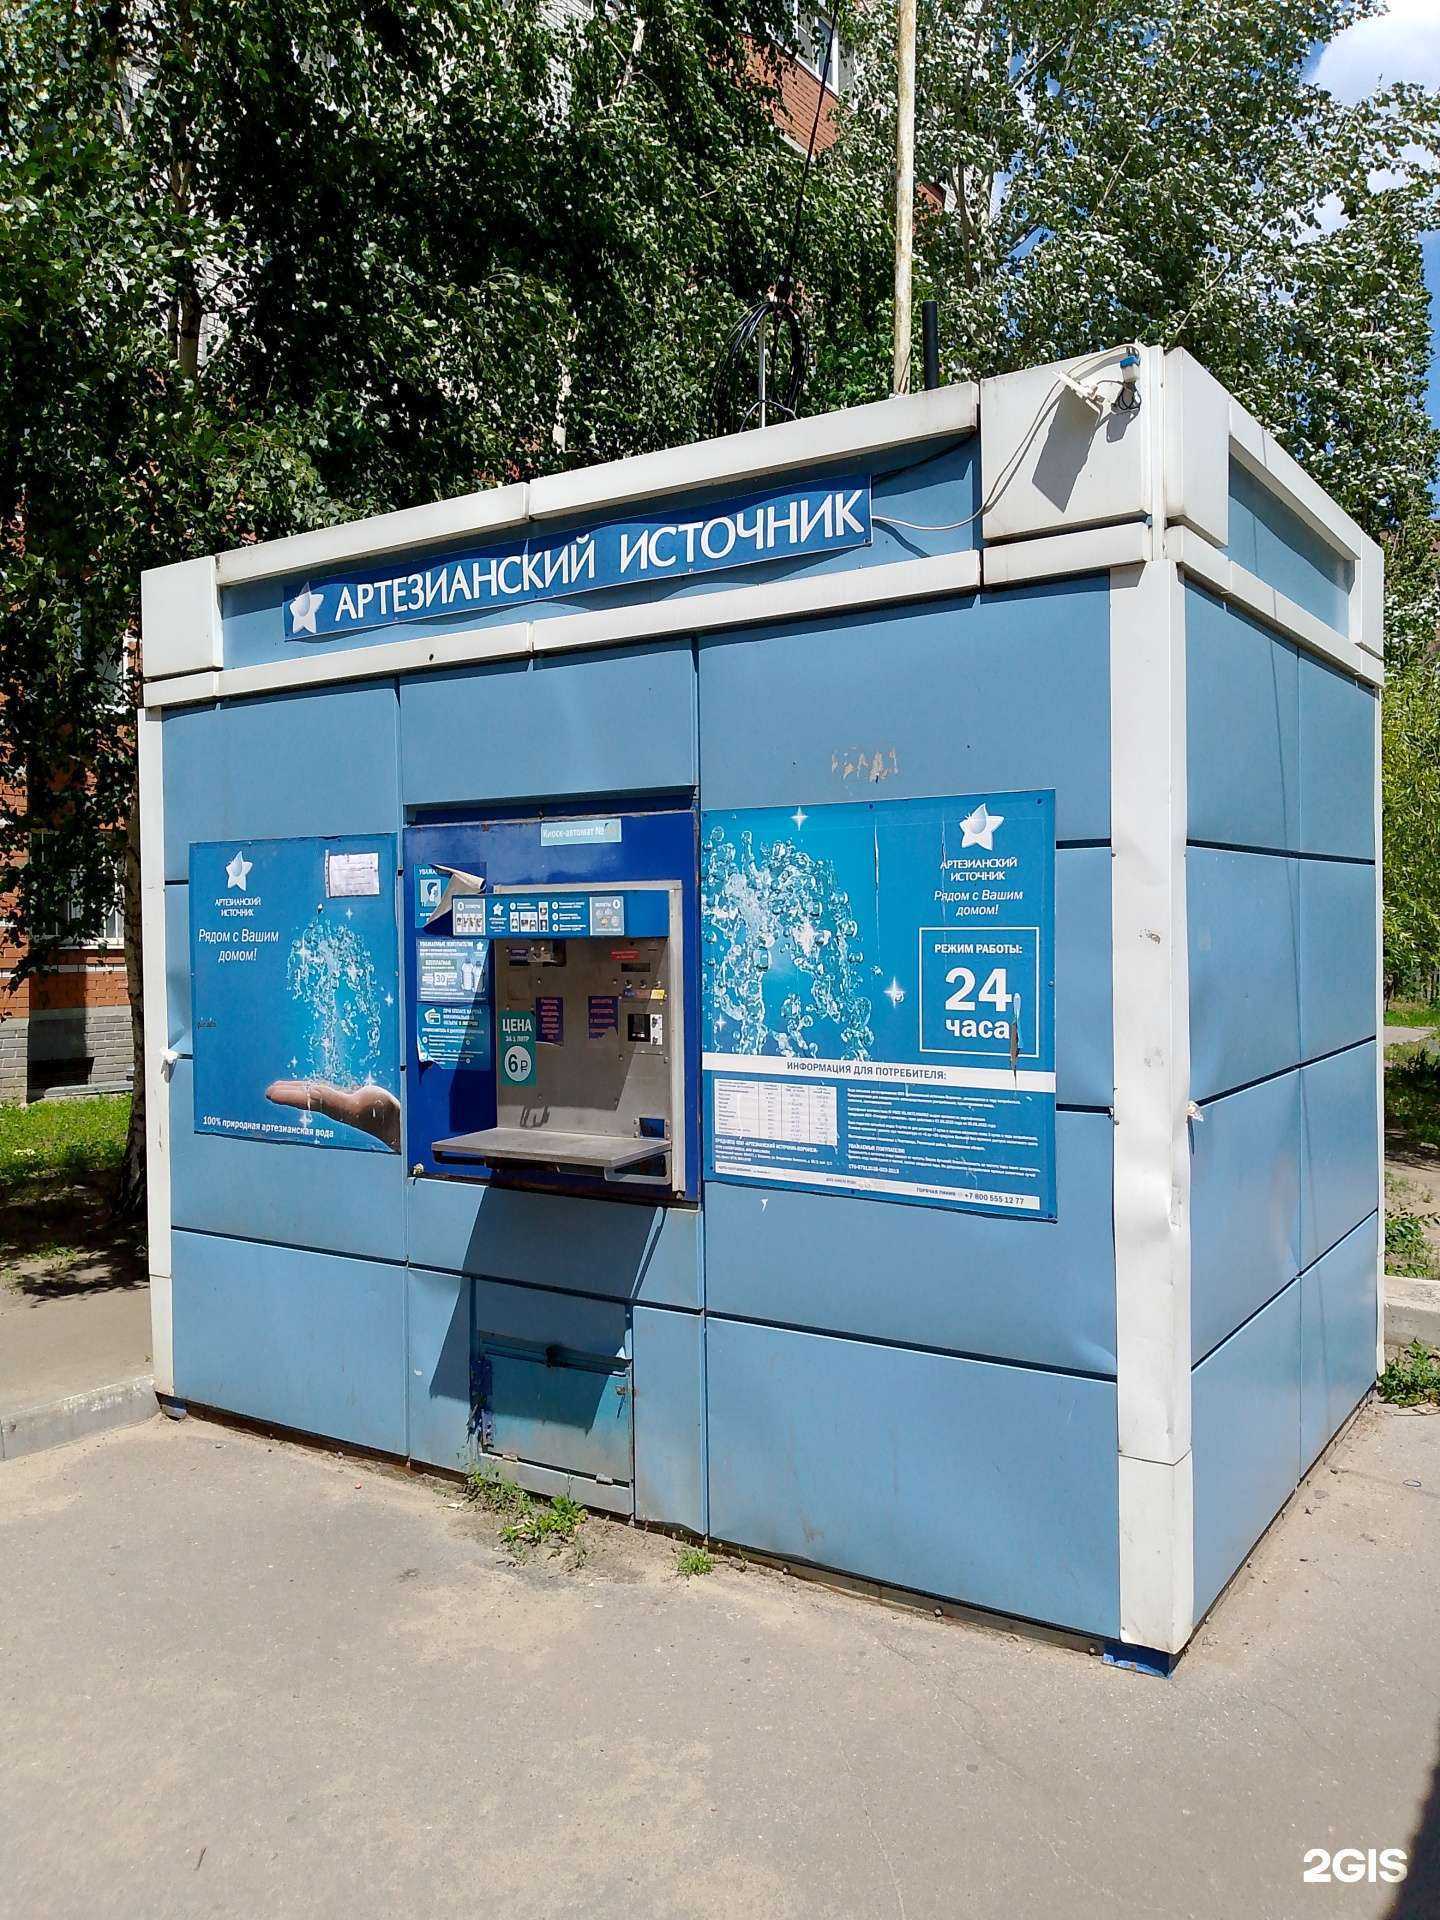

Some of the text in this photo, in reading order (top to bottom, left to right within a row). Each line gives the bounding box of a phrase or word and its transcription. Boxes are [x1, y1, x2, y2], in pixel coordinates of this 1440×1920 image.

[335, 490, 865, 622] АРТЕЗИАНСКИЙ ИСТОЧНИК
[940, 857, 1018, 869] АРТЕЗИАНСКИЙ
[950, 870, 1006, 881] ИСТОЧНИК
[215, 896, 262, 907] АРТЕЗИАНСКИЙ
[934, 889, 1024, 902] Рядом с Вашим
[220, 908, 255, 917] ИСТОЧНИК
[956, 903, 999, 917] домом!
[198, 928, 279, 944] Рядом с Вашим
[218, 947, 258, 963] домом!
[934, 943, 1023, 954] РЕЖИМ РАБОТЫ:
[945, 967, 1013, 1012] 24
[502, 1018, 533, 1034] ЦЕНА
[945, 1019, 1010, 1039] часа
[786, 1061, 947, 1080] ИНФОРМАЦИЯ ДЛЯ ПОТРЕБИТЕЛЯ:
[203, 1115, 334, 1139] 100% природная артезианская вода
[964, 1192, 973, 1200] +7
[974, 1193, 988, 1201] 800
[989, 1194, 1003, 1203] 555
[1004, 1196, 1014, 1204] 12
[1015, 1197, 1025, 1205] 77
